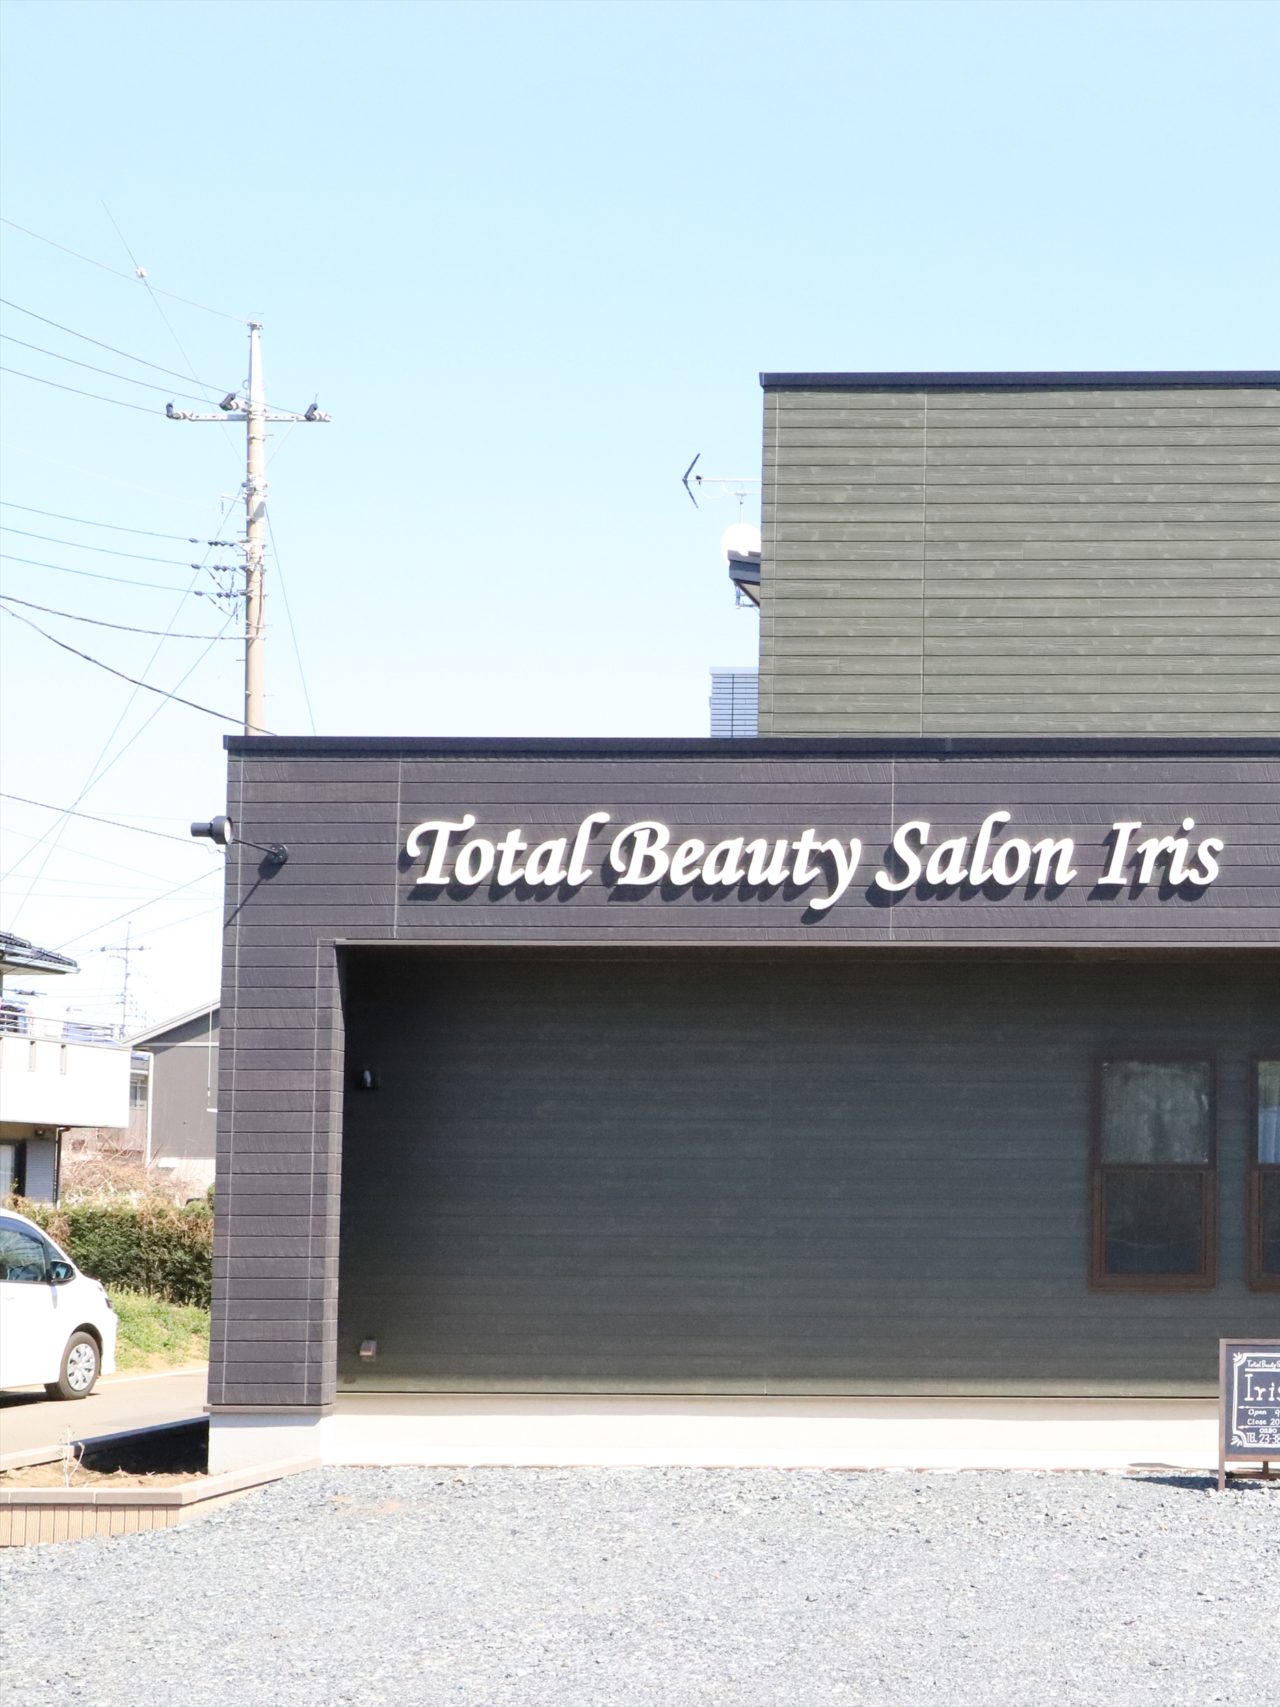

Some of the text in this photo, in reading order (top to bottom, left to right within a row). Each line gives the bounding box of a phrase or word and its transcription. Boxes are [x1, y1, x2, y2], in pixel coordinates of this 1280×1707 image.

[406, 810, 1225, 910] Total Beauty Salon Iris
[1248, 1408, 1267, 1417] Open
[1246, 1432, 1258, 1443] TEL
